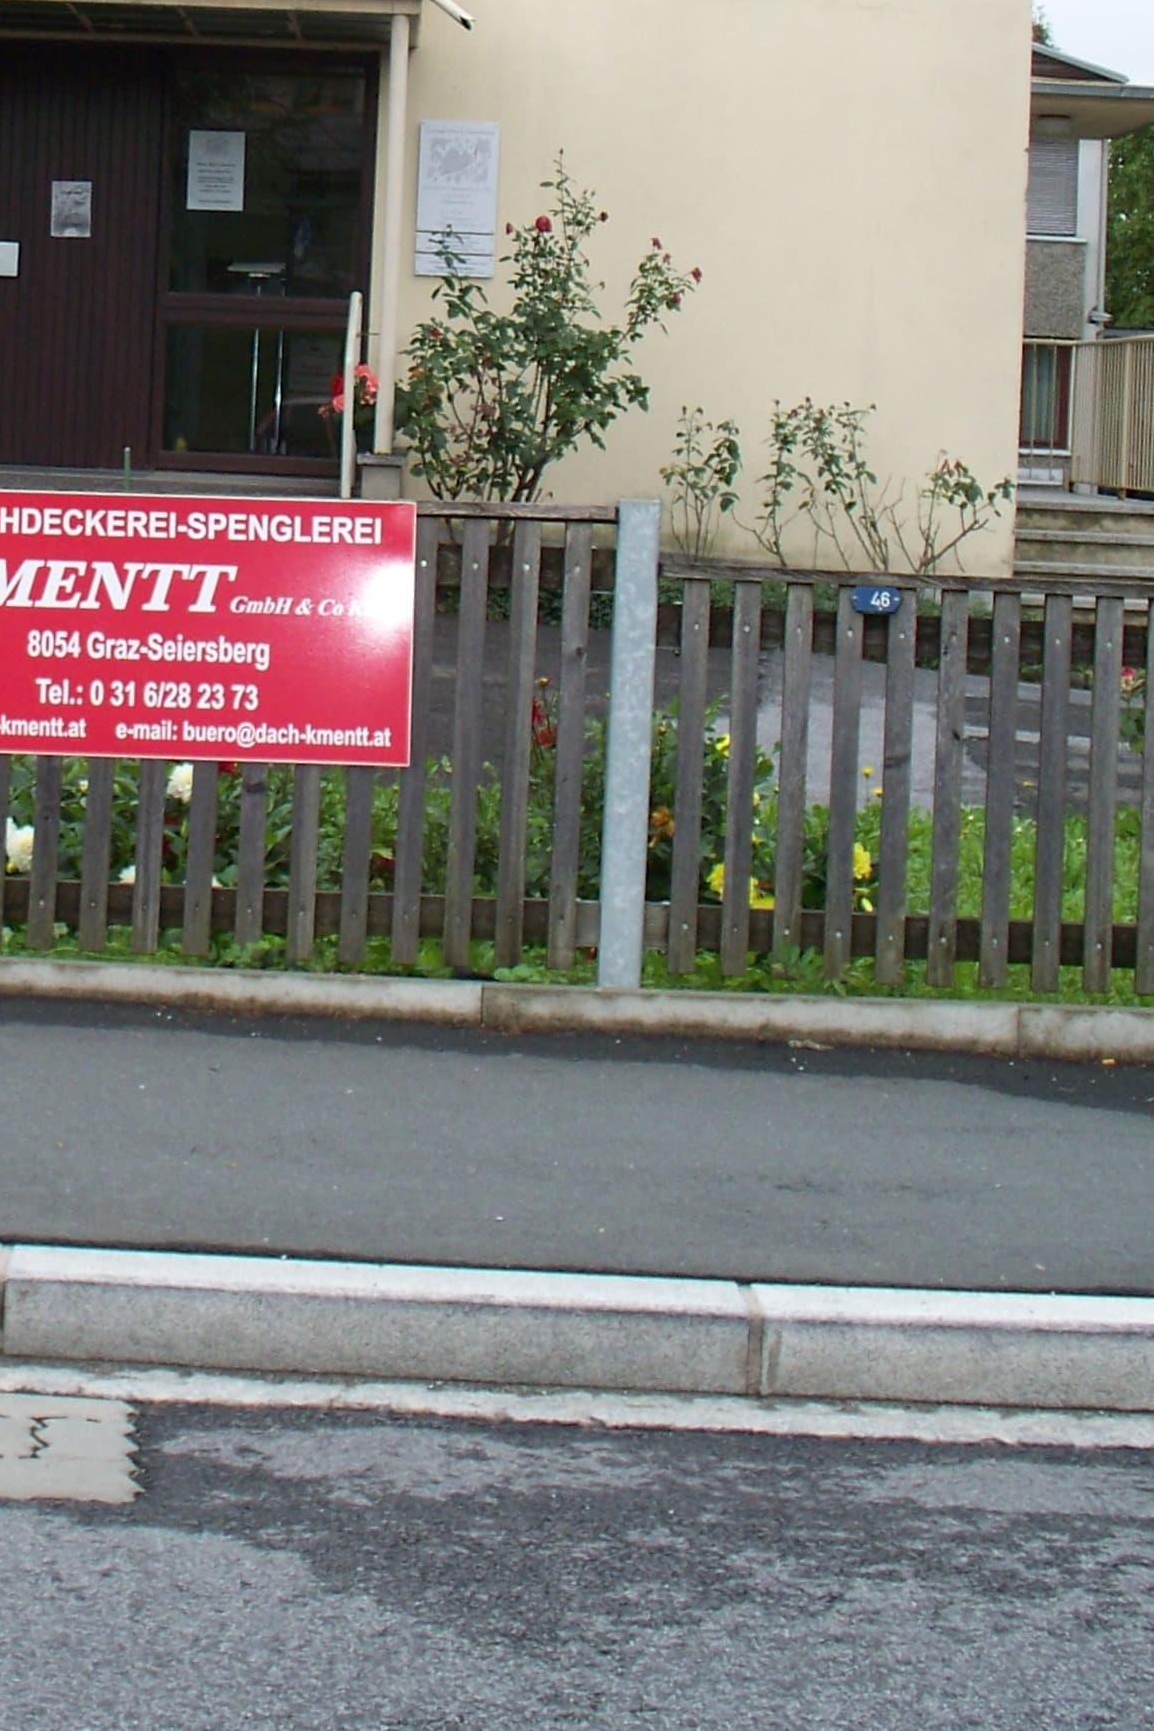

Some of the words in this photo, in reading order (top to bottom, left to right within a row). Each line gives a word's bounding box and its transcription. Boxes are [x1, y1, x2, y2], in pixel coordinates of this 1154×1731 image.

[230, 595, 293, 615] GmbH
[295, 597, 314, 616] &
[318, 598, 344, 616] Co
[870, 591, 891, 608] 46
[27, 631, 81, 659] 8054
[86, 632, 271, 670] Graz-Seiersberg
[36, 678, 83, 707] Tel.:
[89, 680, 104, 706] 0
[110, 680, 136, 707] 31
[143, 682, 191, 709] 6/28
[196, 683, 225, 710] 23
[231, 684, 259, 711] 73
[115, 718, 178, 742] e-mail:
[182, 723, 391, 748] buero@dach-kmentt.at
